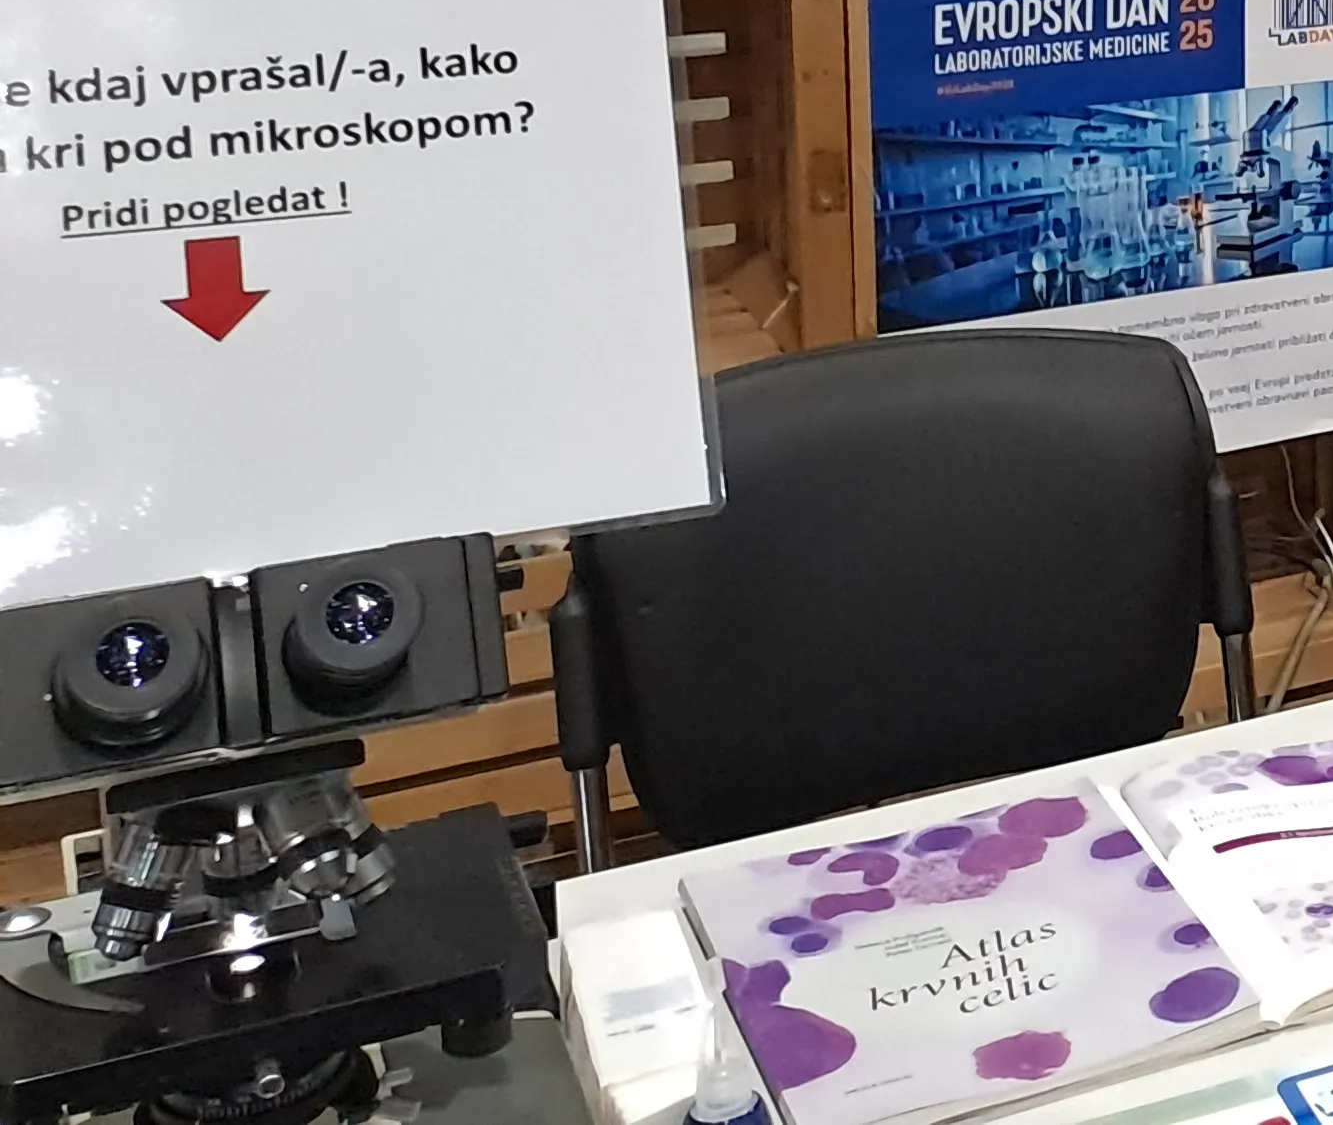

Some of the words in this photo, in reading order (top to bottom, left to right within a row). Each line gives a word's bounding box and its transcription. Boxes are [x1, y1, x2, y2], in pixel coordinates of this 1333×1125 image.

[934, 38, 1084, 75] LABORATORIJSKE
[1089, 32, 1170, 62] MEDICINE
[1179, 19, 1215, 51] 25
[47, 65, 146, 108] kdaj
[162, 49, 405, 101] vprašal/-a,
[419, 42, 519, 81] kako
[26, 133, 86, 171] kri
[104, 126, 192, 173] pod
[209, 101, 535, 158] mikroskopom?
[62, 198, 149, 232] Pridi
[163, 186, 326, 229] pogledat
[941, 922, 1057, 970] Atlas
[869, 954, 1028, 1011] krvnih
[959, 972, 1060, 1014] celic
